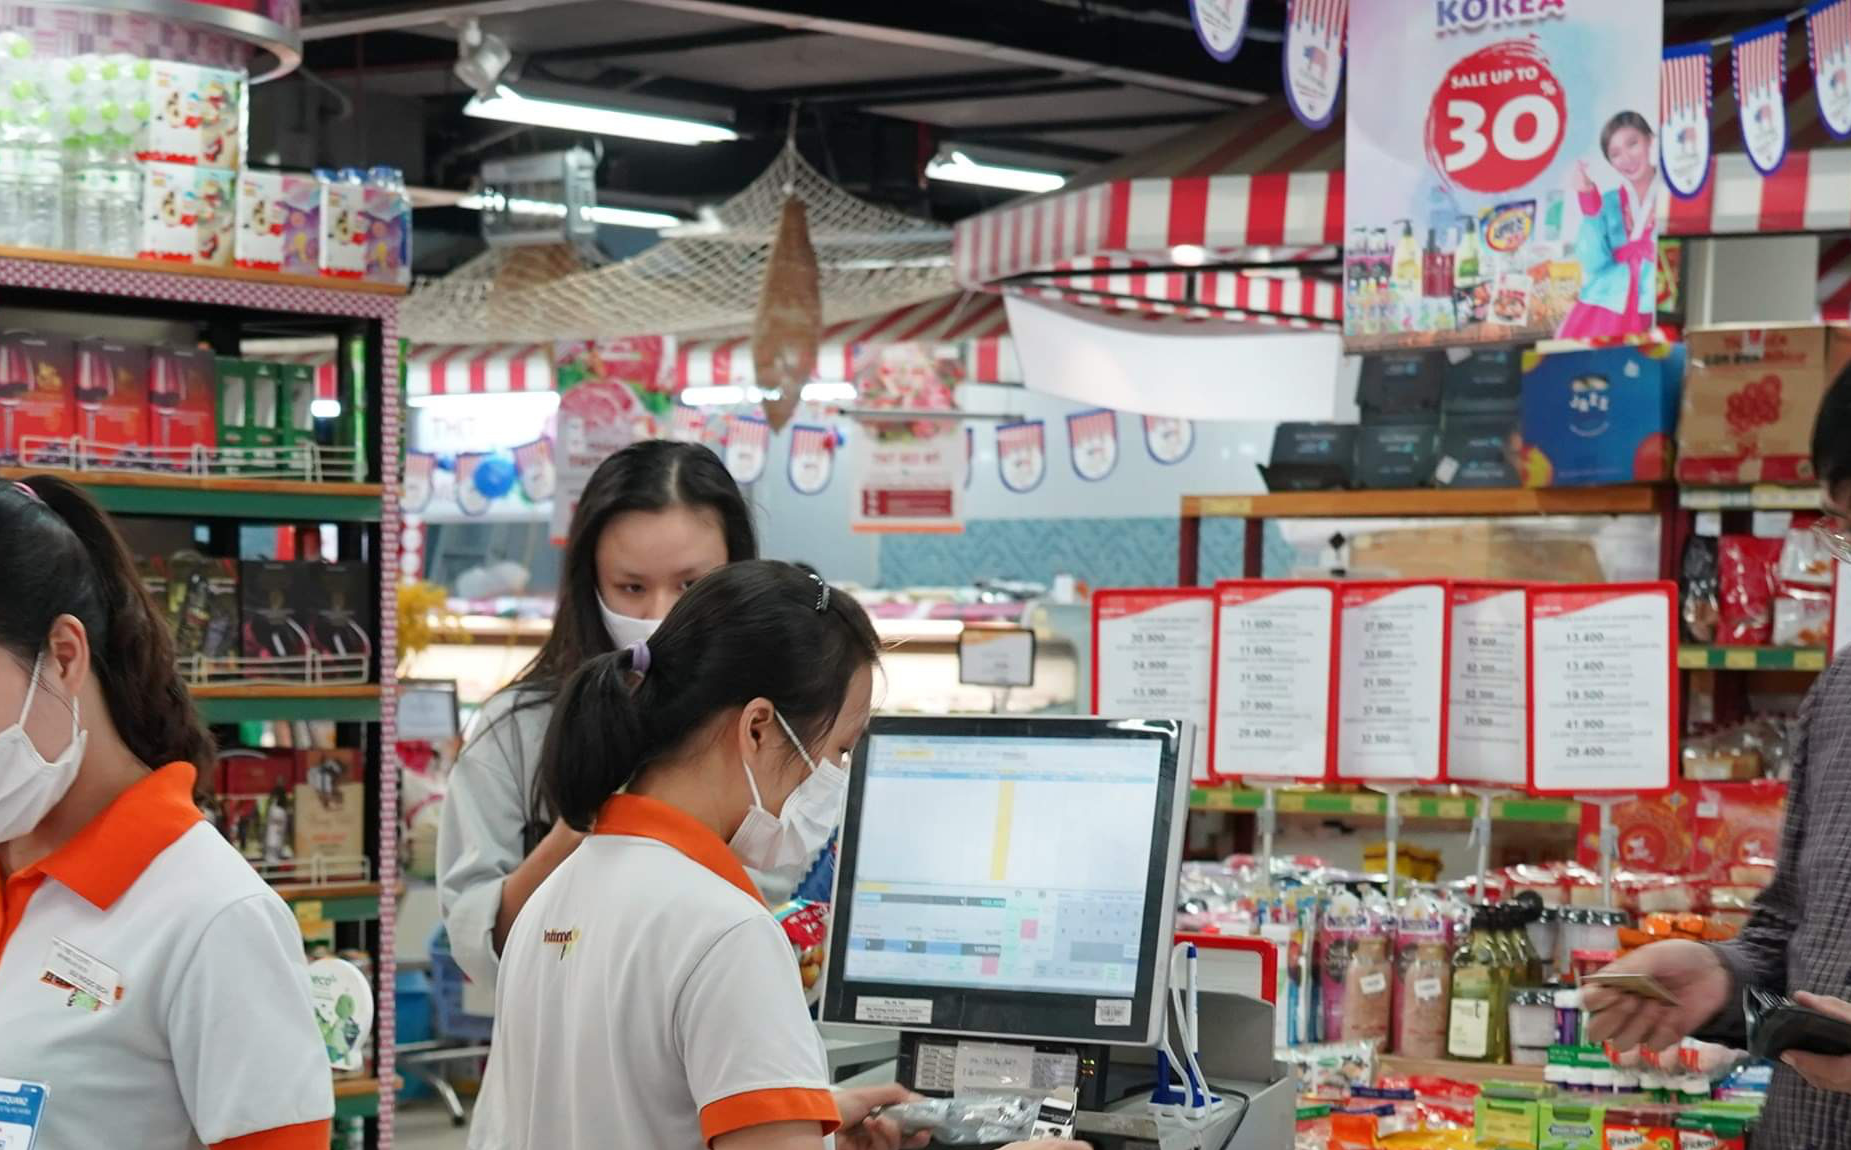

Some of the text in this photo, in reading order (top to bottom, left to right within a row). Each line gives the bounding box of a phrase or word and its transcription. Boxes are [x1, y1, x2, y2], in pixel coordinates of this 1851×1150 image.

[1451, 66, 1539, 89] SALE UP TO
[1446, 95, 1559, 172] 30
